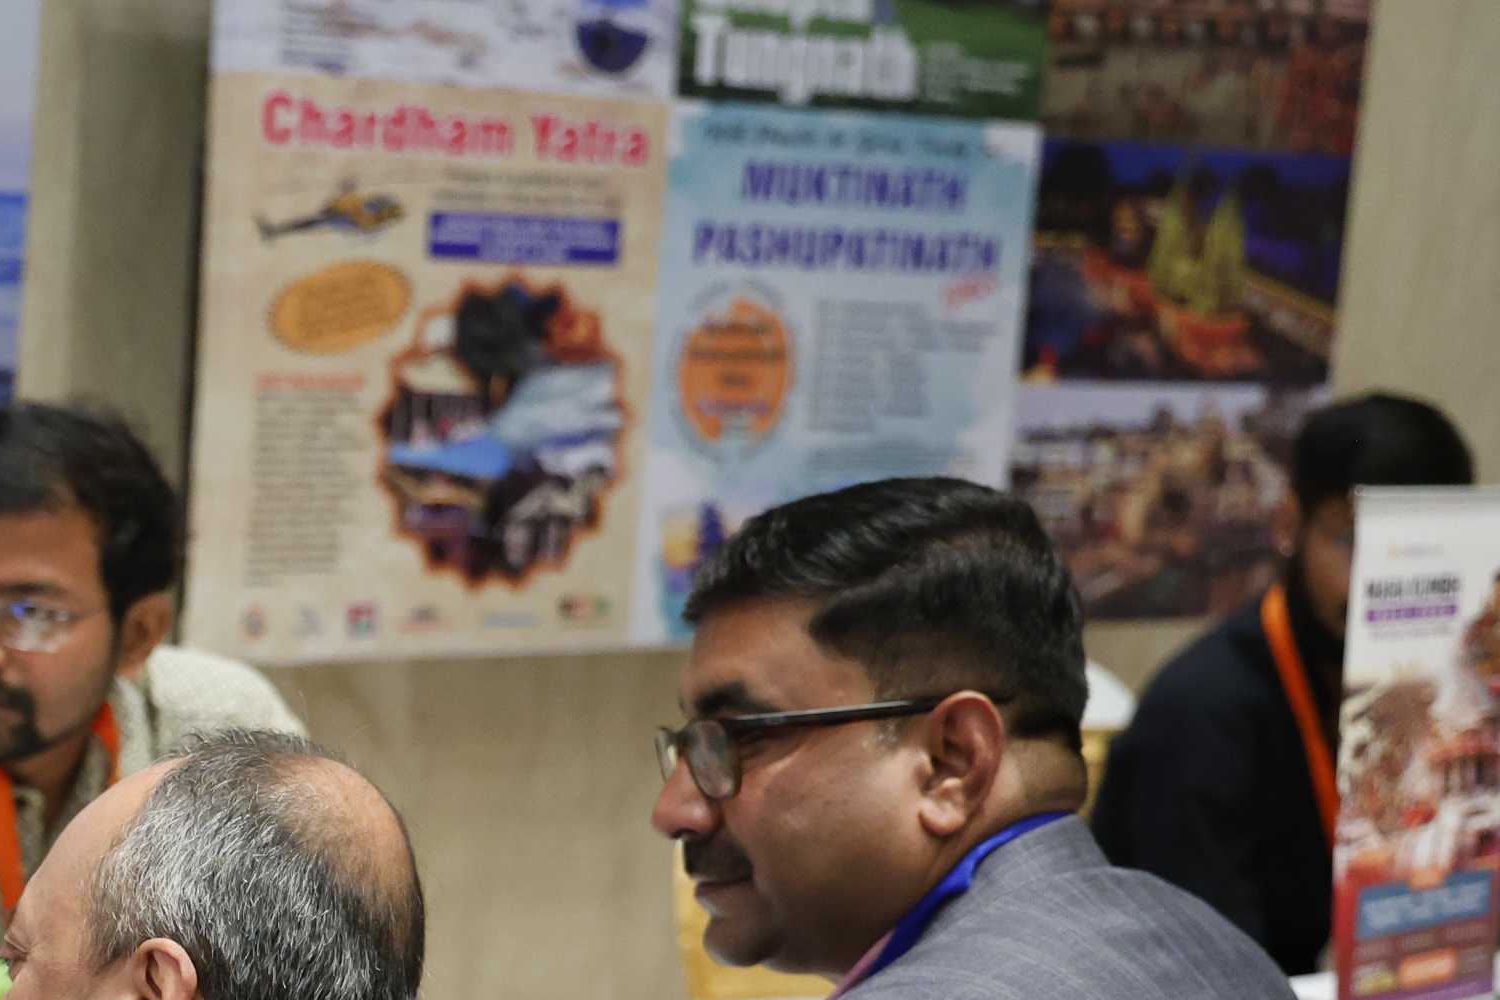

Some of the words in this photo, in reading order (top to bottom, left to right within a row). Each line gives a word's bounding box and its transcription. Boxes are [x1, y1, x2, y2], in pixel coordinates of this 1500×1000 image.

[263, 91, 514, 156] Chardham
[529, 114, 649, 165] Yatra
[743, 159, 967, 213] MUKTINATH
[693, 221, 1000, 272] PASHUPATINATH
